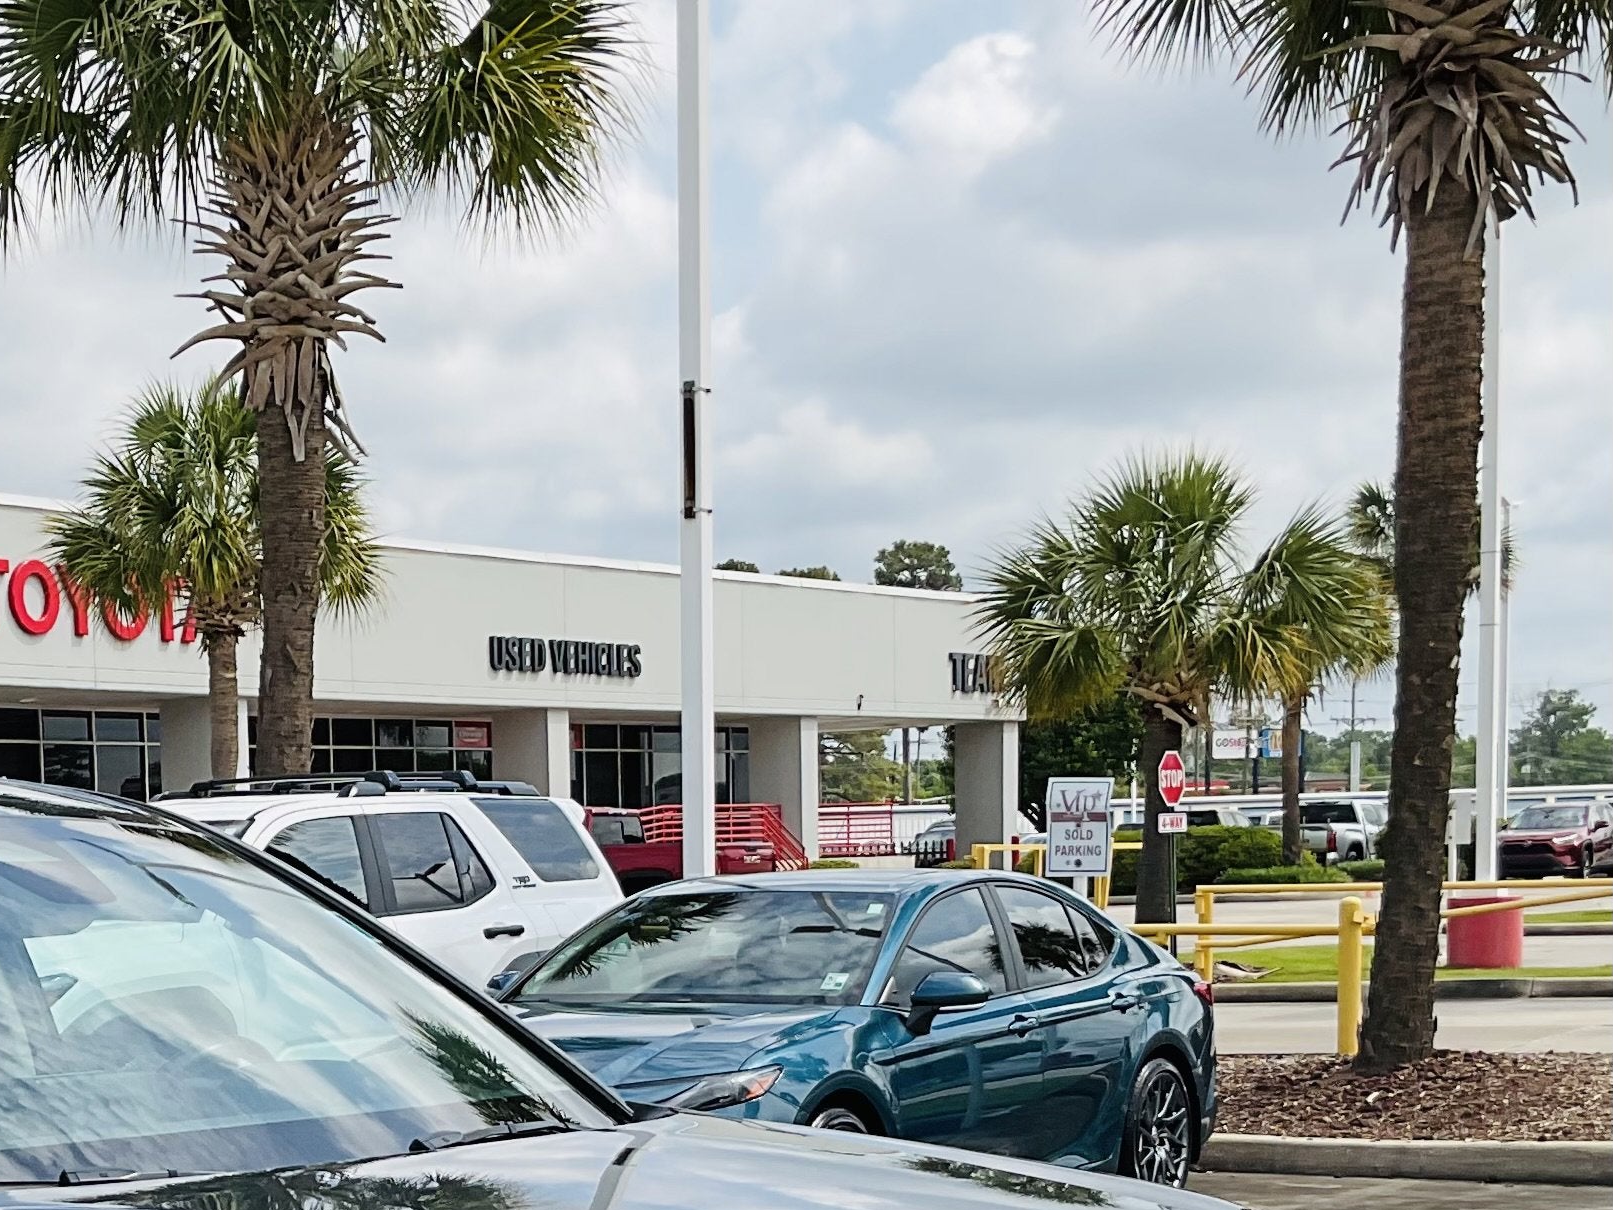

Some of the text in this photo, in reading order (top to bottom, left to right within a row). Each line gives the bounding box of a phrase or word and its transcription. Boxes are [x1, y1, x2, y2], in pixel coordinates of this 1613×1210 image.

[489, 636, 642, 677] USED VEHICLES
[1161, 769, 1183, 788] STOP
[1064, 829, 1093, 840] SOLD
[1055, 845, 1102, 856] PARKING
